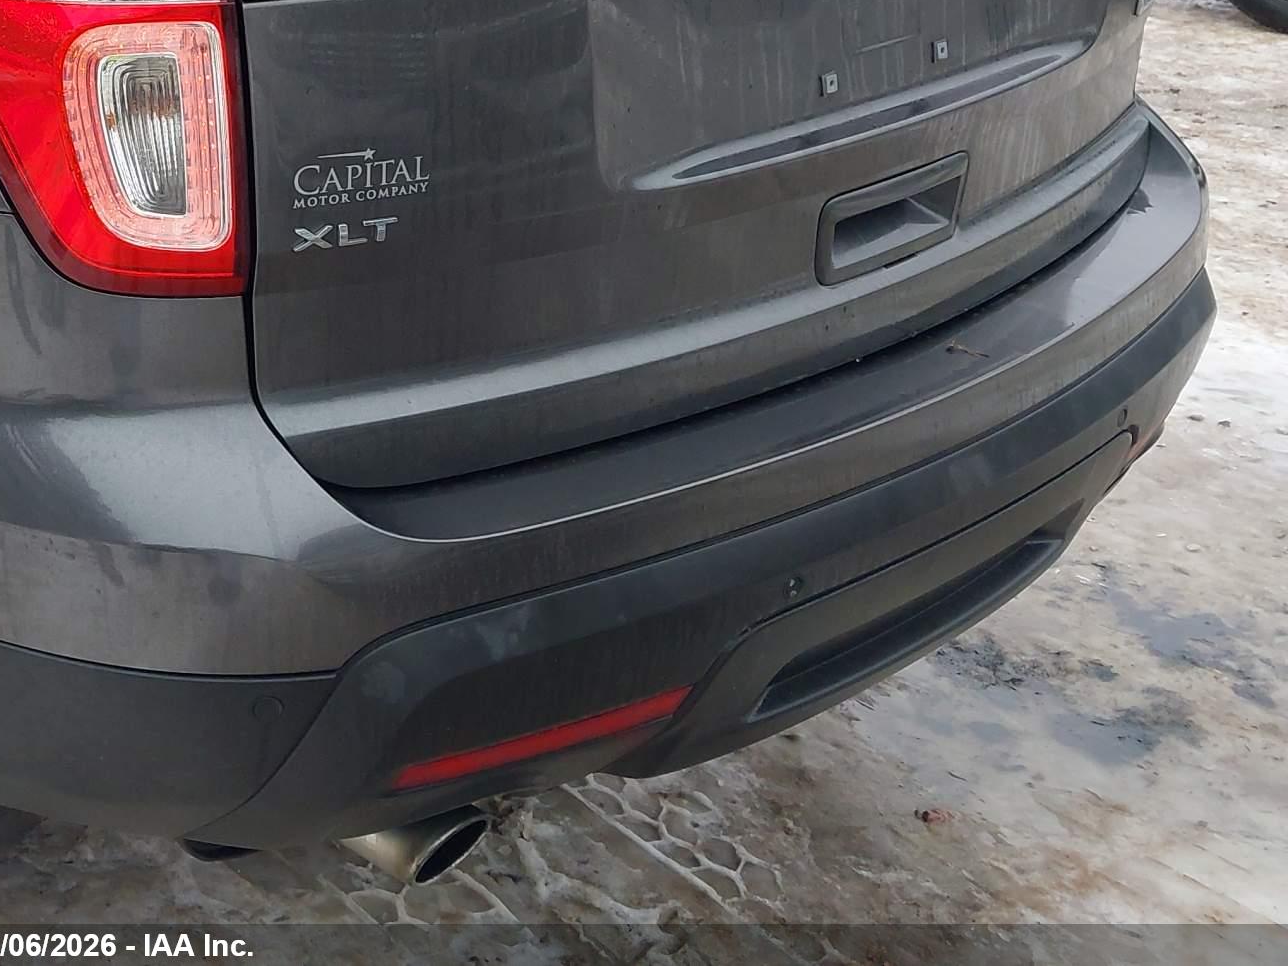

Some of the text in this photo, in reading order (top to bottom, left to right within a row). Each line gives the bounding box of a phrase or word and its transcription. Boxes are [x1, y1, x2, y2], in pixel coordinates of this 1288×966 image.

[293, 156, 430, 196] CAPITAL
[293, 181, 429, 209] MOTOR COMPANY
[292, 217, 399, 253] XLT
